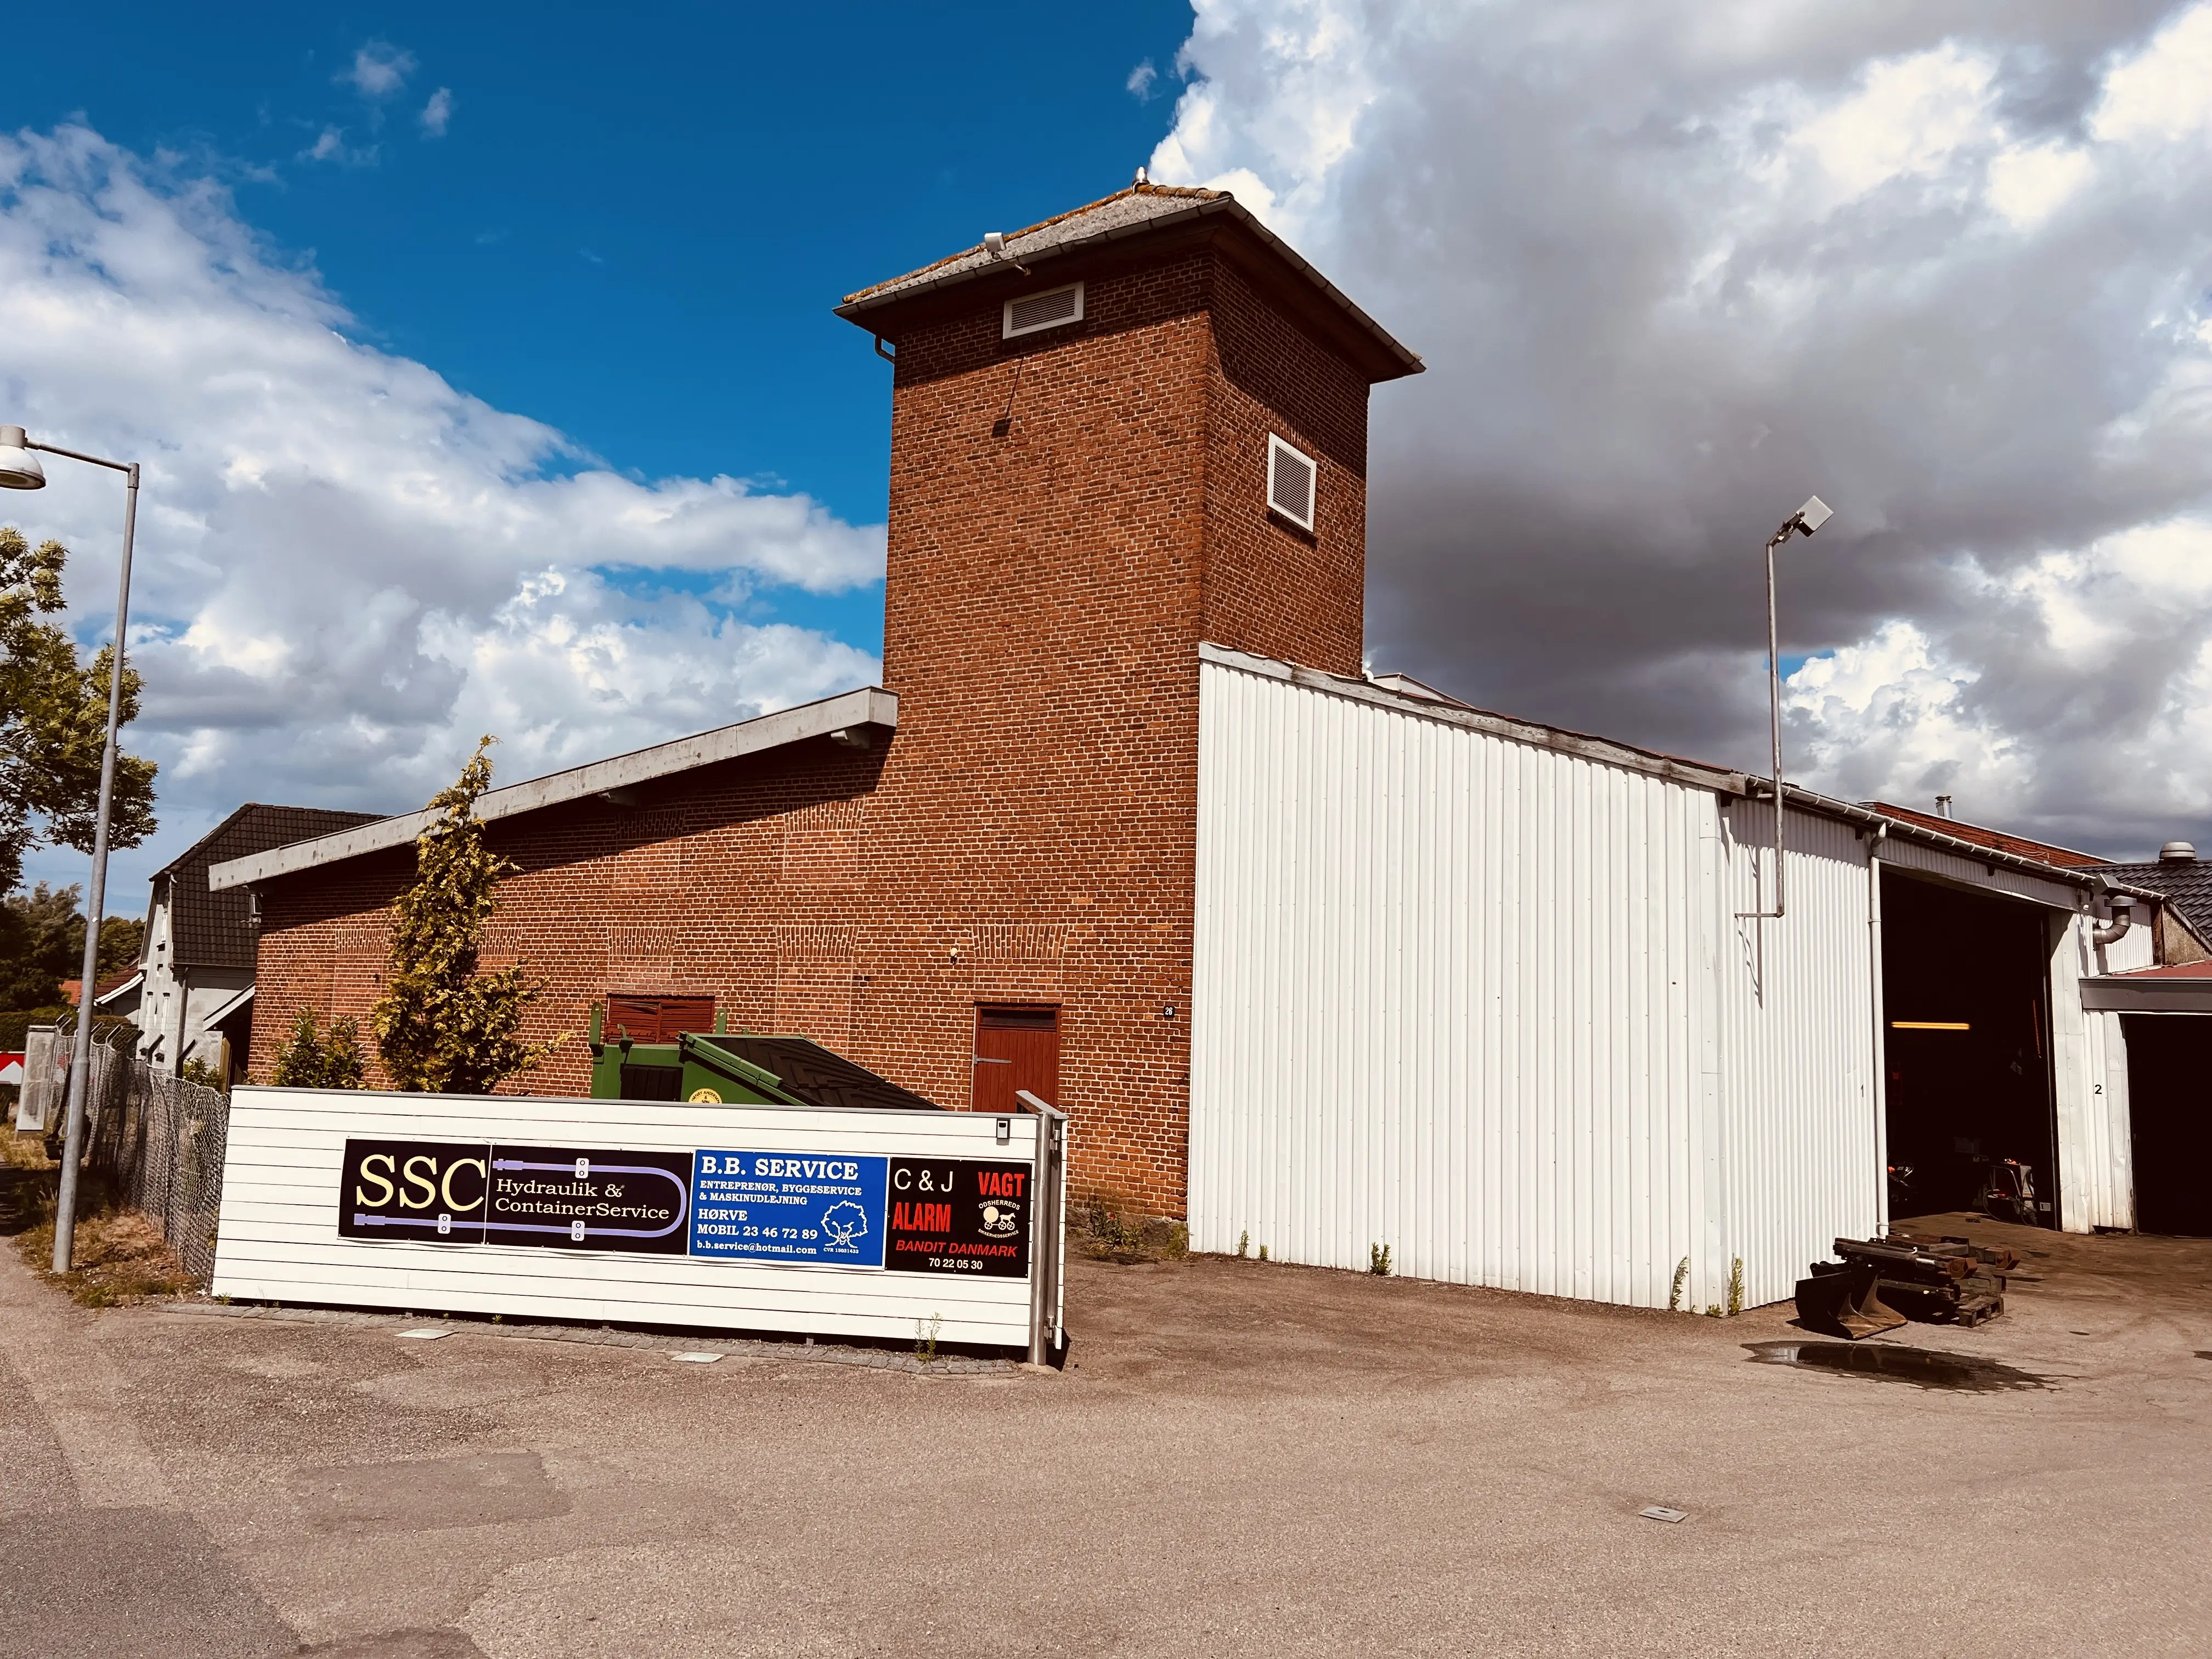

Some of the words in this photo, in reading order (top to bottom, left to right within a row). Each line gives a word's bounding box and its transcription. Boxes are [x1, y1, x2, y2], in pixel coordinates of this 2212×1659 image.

[1165, 1007, 1173, 1015] 26
[2095, 1084, 2102, 1094] 2
[701, 1156, 746, 1175] B.B.
[755, 1158, 859, 1180] SERVICE
[357, 1154, 486, 1211] SSC
[496, 1178, 598, 1197] Hydraulik
[605, 1184, 622, 1198] &
[699, 1180, 779, 1193] ENTREPRENØR,
[782, 1184, 862, 1196] BYGGESERVICE
[894, 1168, 911, 1190] C
[918, 1170, 934, 1191] &
[941, 1171, 953, 1192] J
[978, 1171, 1025, 1197] VAGT
[699, 1192, 707, 1200] &
[709, 1192, 808, 1205] MASKINUDLEJNING
[978, 1199, 1020, 1211] ODSHERREDS
[495, 1198, 670, 1220] ContainerService
[697, 1208, 748, 1221] HØRVE
[892, 1201, 951, 1233] ALARM
[697, 1223, 740, 1235] MOBIL
[743, 1226, 759, 1237] 23
[762, 1227, 778, 1238] 46
[782, 1228, 798, 1239] 72
[802, 1229, 818, 1240] 89
[697, 1240, 817, 1255] b.b.service@hotmail.com
[895, 1239, 947, 1253] BANDIT
[949, 1243, 1018, 1257] DANMARK
[929, 1257, 940, 1267] 70
[943, 1259, 955, 1268] 22
[957, 1259, 969, 1269] 05
[970, 1260, 983, 1269] 30
